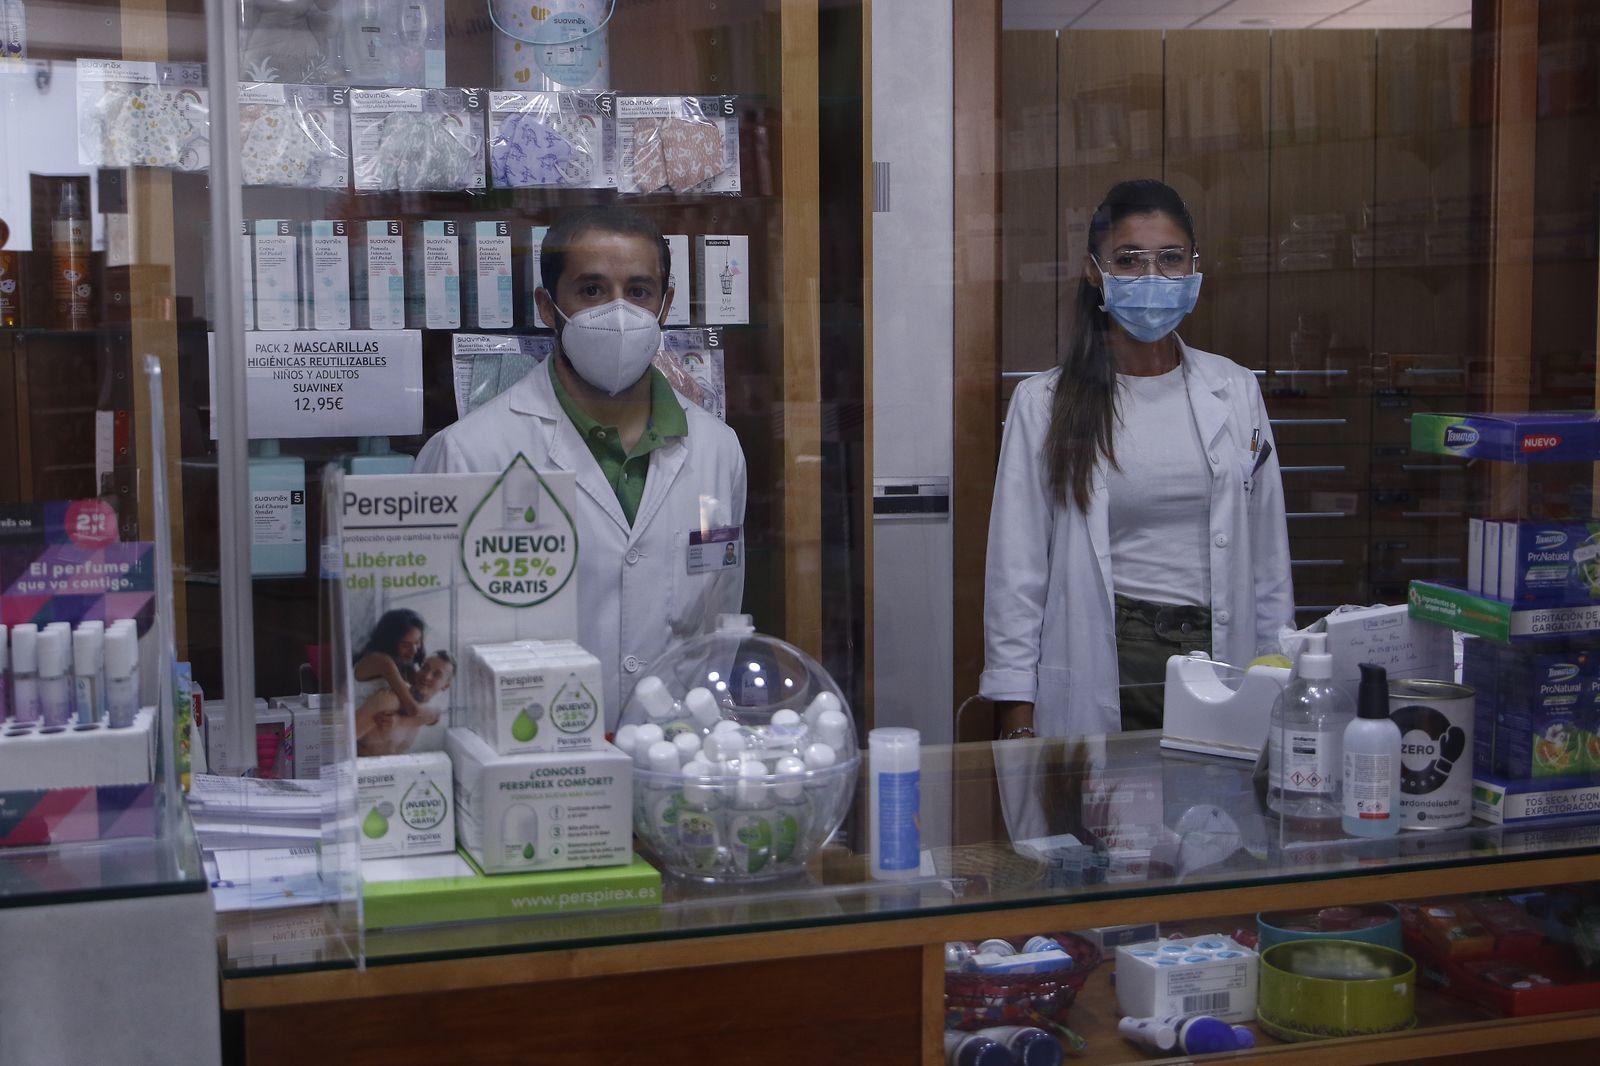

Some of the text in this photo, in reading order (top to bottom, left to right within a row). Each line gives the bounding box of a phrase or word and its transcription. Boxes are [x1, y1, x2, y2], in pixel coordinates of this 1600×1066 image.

[255, 341, 379, 353] PACK 2 MASCARILLAS
[247, 355, 387, 367] HIGIÉNICAS REUTILIZABLES
[273, 368, 360, 380] NIÑOS Y ADULTOS
[293, 383, 344, 393] SUAVINEX
[294, 397, 344, 413] 12,95€
[1524, 437, 1557, 448] NUEVO
[343, 490, 458, 521] Perspirex
[475, 535, 566, 558] ¡NUEVO!
[344, 551, 427, 568] Libérate
[1527, 551, 1570, 562] ProNatural
[30, 560, 130, 578] El perfume
[480, 557, 557, 577] +25%
[17, 579, 46, 592] que
[49, 580, 68, 589] va
[346, 572, 441, 589] del sudor.
[488, 580, 548, 594] GRATIS
[1585, 610, 1598, 620] DE
[1531, 621, 1583, 633] GARGANTA
[1584, 620, 1591, 629] Y
[1540, 682, 1582, 694] ProNatural
[1400, 744, 1435, 755] ZERO
[529, 766, 586, 780] ¿CONOCES
[499, 776, 614, 791] PERSPIREX COMFORT?
[1525, 792, 1599, 807] TOS SECA Y CON
[511, 886, 657, 909] www.perspirex.es
